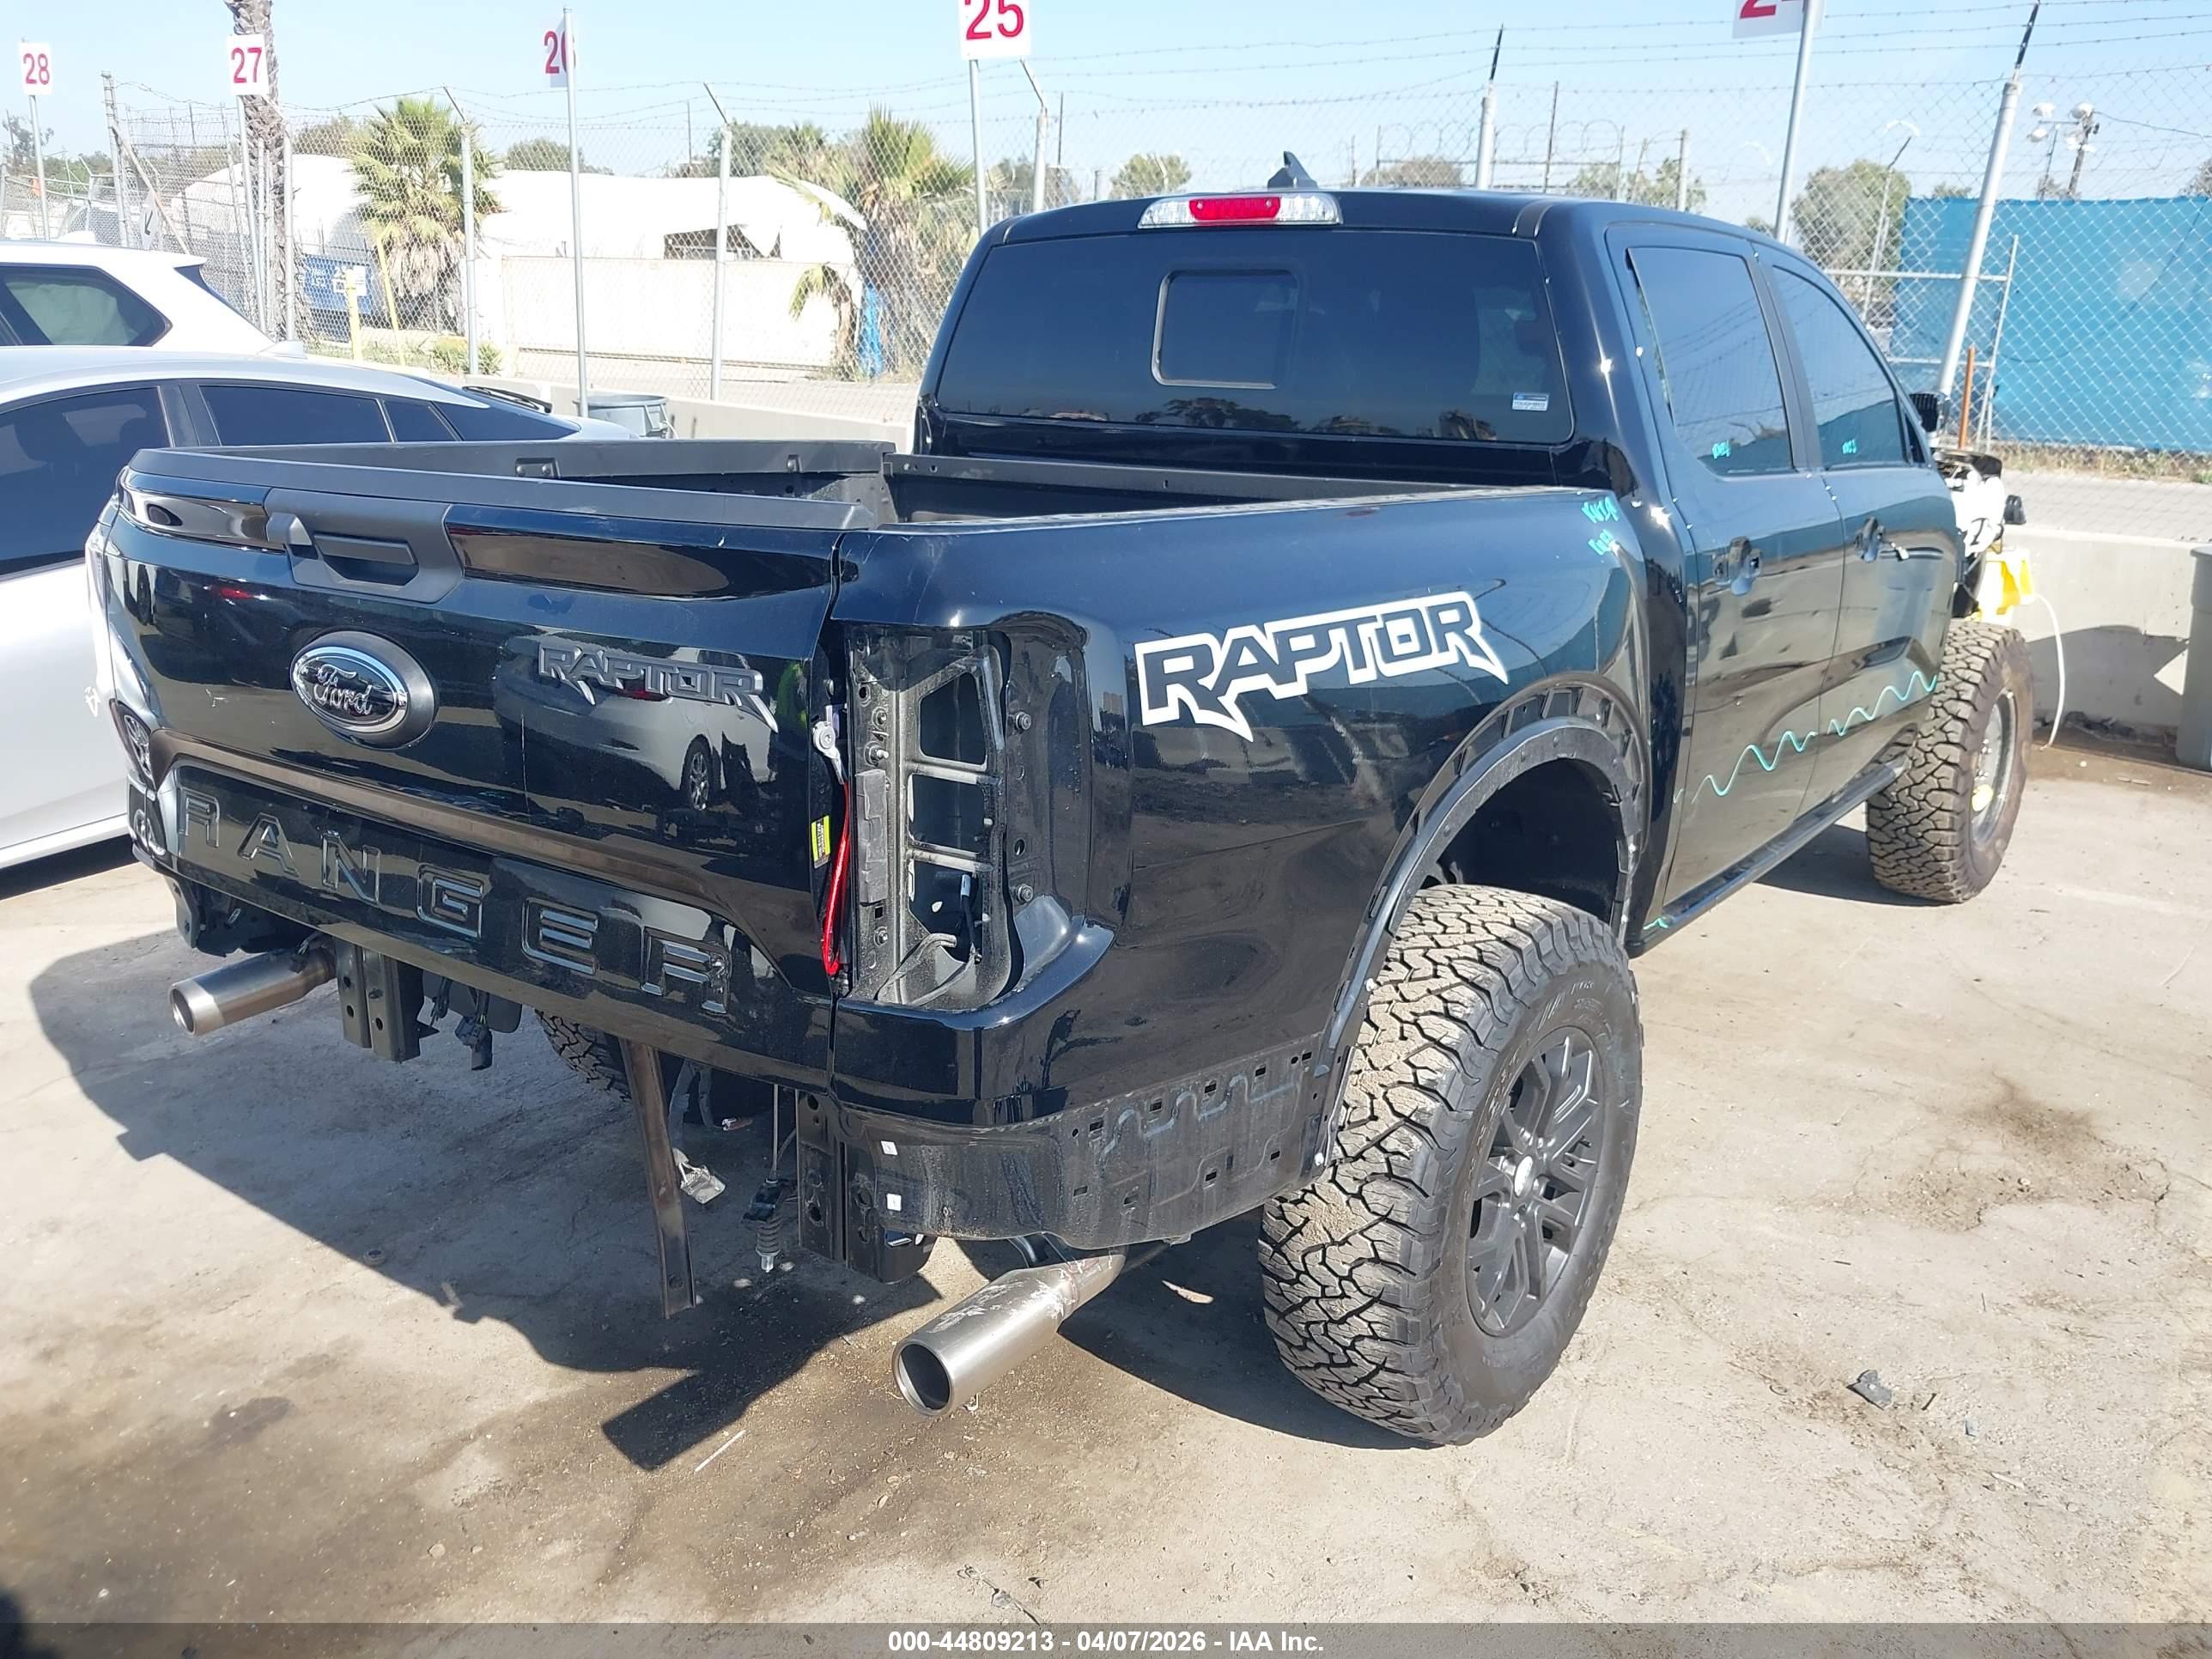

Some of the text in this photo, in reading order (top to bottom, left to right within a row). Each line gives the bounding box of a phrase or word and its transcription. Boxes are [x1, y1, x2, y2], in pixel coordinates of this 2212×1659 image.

[964, 0, 1024, 40] 25
[23, 53, 50, 85] 28
[231, 47, 262, 83] 27
[313, 663, 373, 715] Ford
[538, 644, 778, 733] RAPTOR
[1135, 591, 1509, 742] RAPTOR
[179, 786, 733, 1015] RANGER
